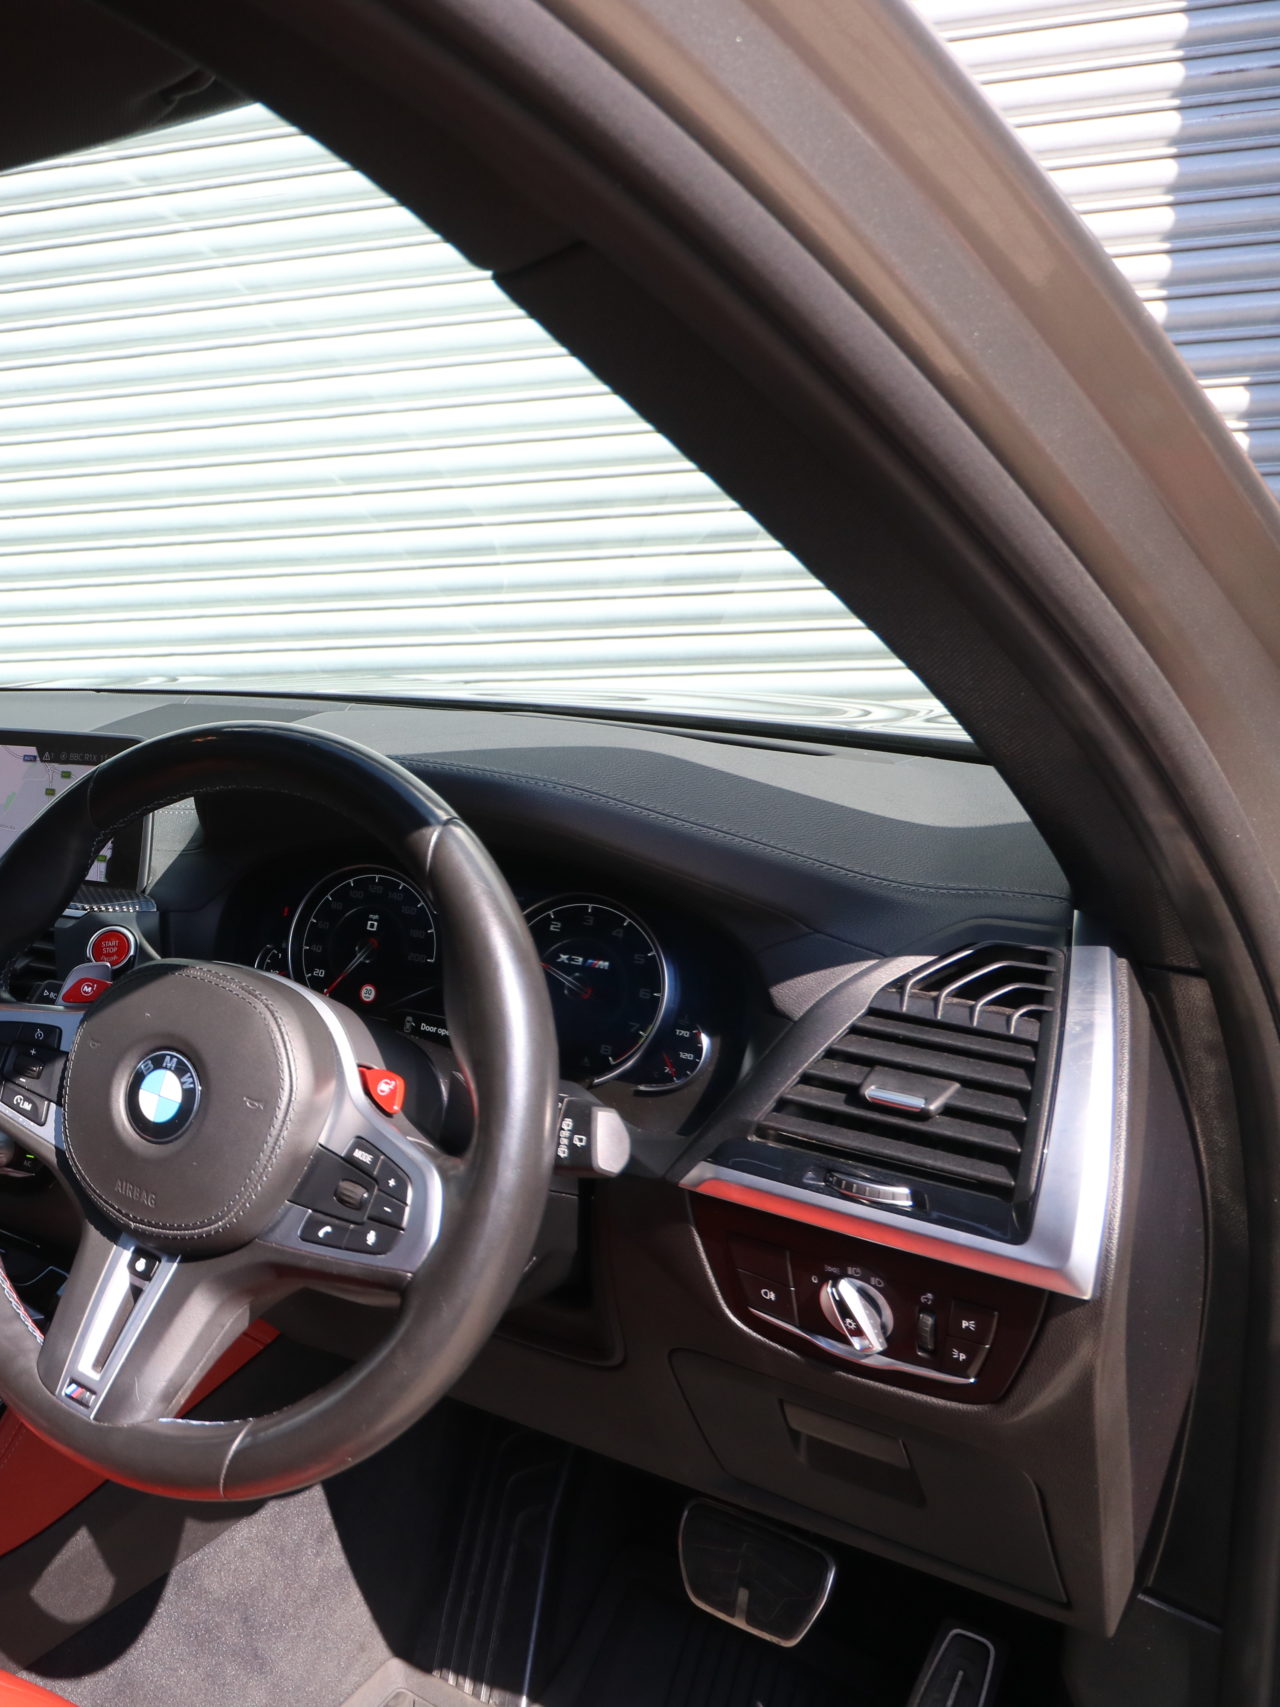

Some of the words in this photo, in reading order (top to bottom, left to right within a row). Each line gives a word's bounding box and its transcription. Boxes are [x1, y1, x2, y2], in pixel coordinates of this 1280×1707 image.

[366, 920, 378, 931] 0
[583, 915, 594, 926] 3
[549, 921, 562, 932] 2
[101, 940, 119, 948] START
[556, 953, 583, 966] X3
[312, 968, 325, 978] 20
[363, 987, 373, 996] 30
[420, 1022, 437, 1033] Door
[675, 1029, 690, 1038] 170
[679, 1051, 694, 1061] 120
[140, 1054, 194, 1090] BMW
[352, 1148, 374, 1165] MODE
[114, 1179, 156, 1209] AIRBAG
